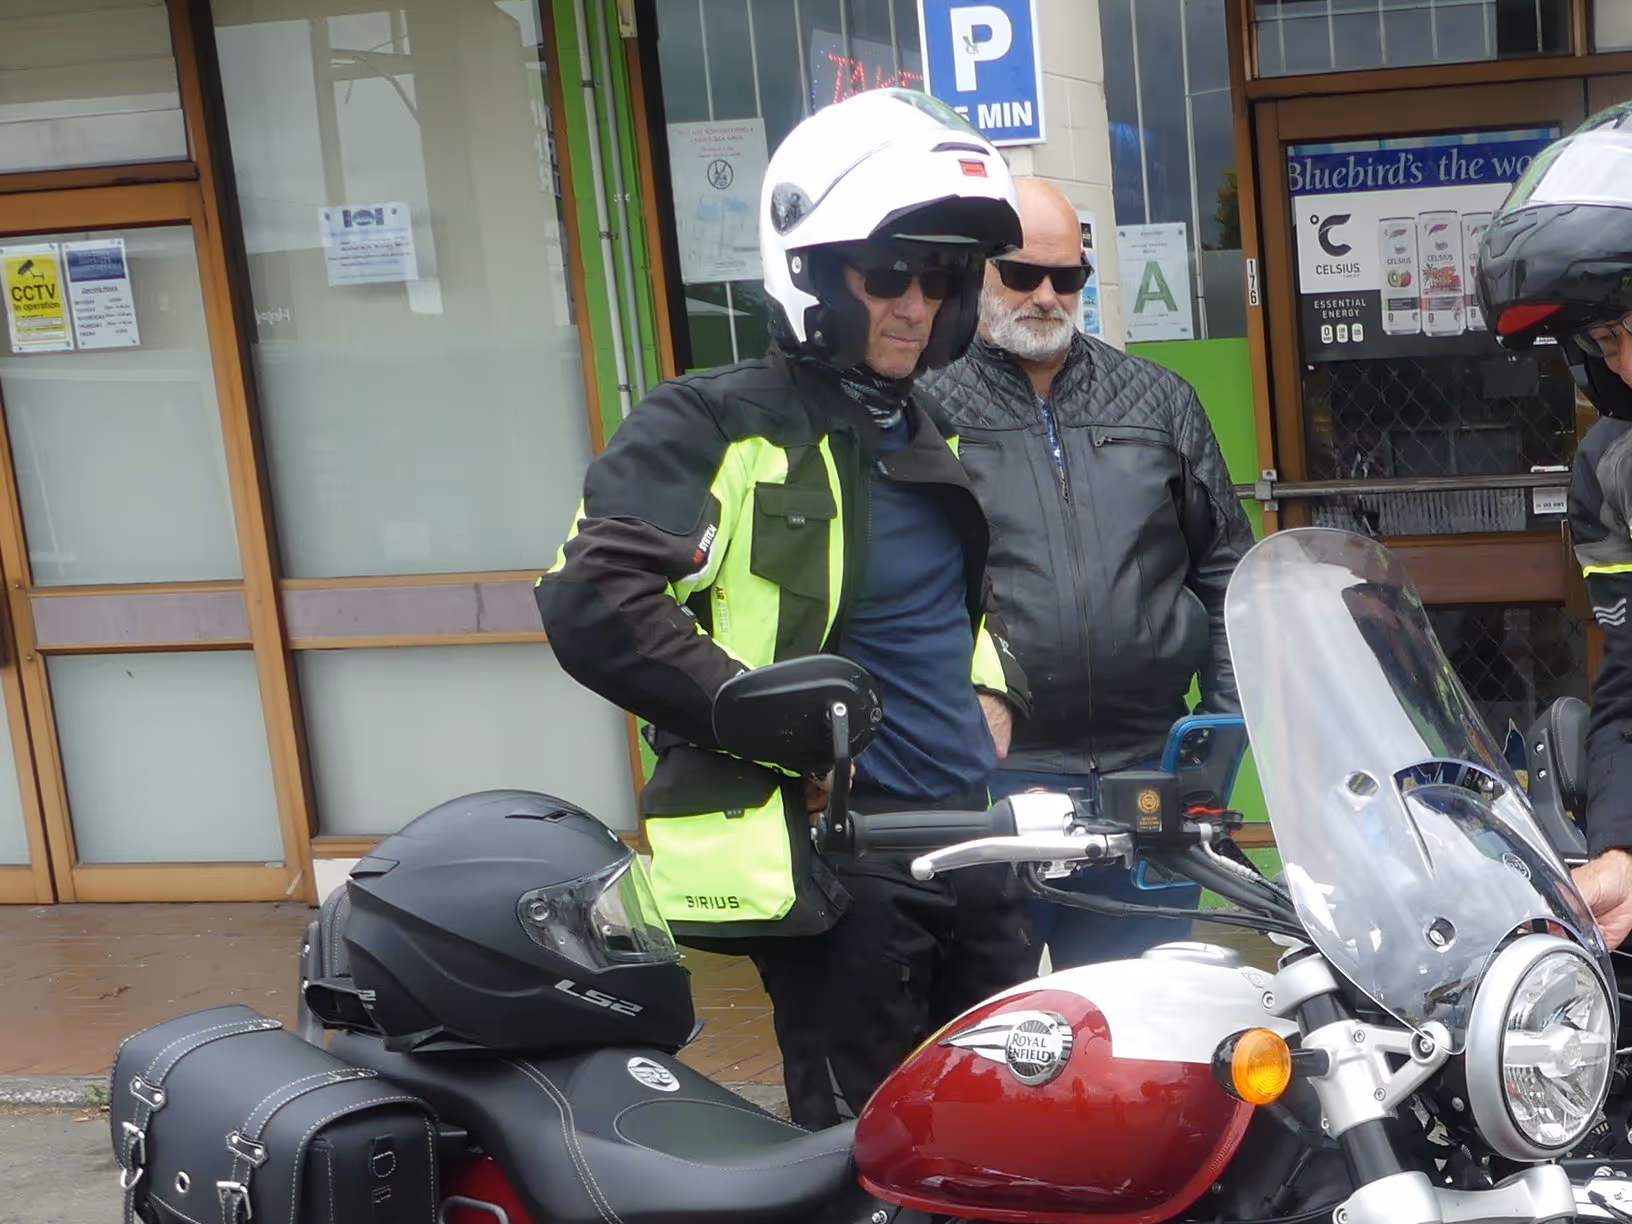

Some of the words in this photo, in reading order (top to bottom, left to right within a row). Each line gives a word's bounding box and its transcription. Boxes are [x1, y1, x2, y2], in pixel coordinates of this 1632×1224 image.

[950, 5, 1012, 92] P
[978, 101, 1033, 129] MIN
[1288, 153, 1423, 191] Bluebird's
[1439, 148, 1484, 181] the
[1491, 154, 1533, 178] wo
[1315, 263, 1361, 275] CELSIUS
[11, 284, 55, 302] CCTV
[1133, 261, 1178, 314] A
[23, 302, 60, 312] operation
[1314, 298, 1366, 309] ESSENTIAL
[1322, 309, 1360, 319] ENERGY
[685, 895, 740, 909] SIRIUS
[554, 979, 644, 1016] LS2
[1011, 1033, 1047, 1048] ROYAL
[1008, 1046, 1052, 1063] ENFIELD
